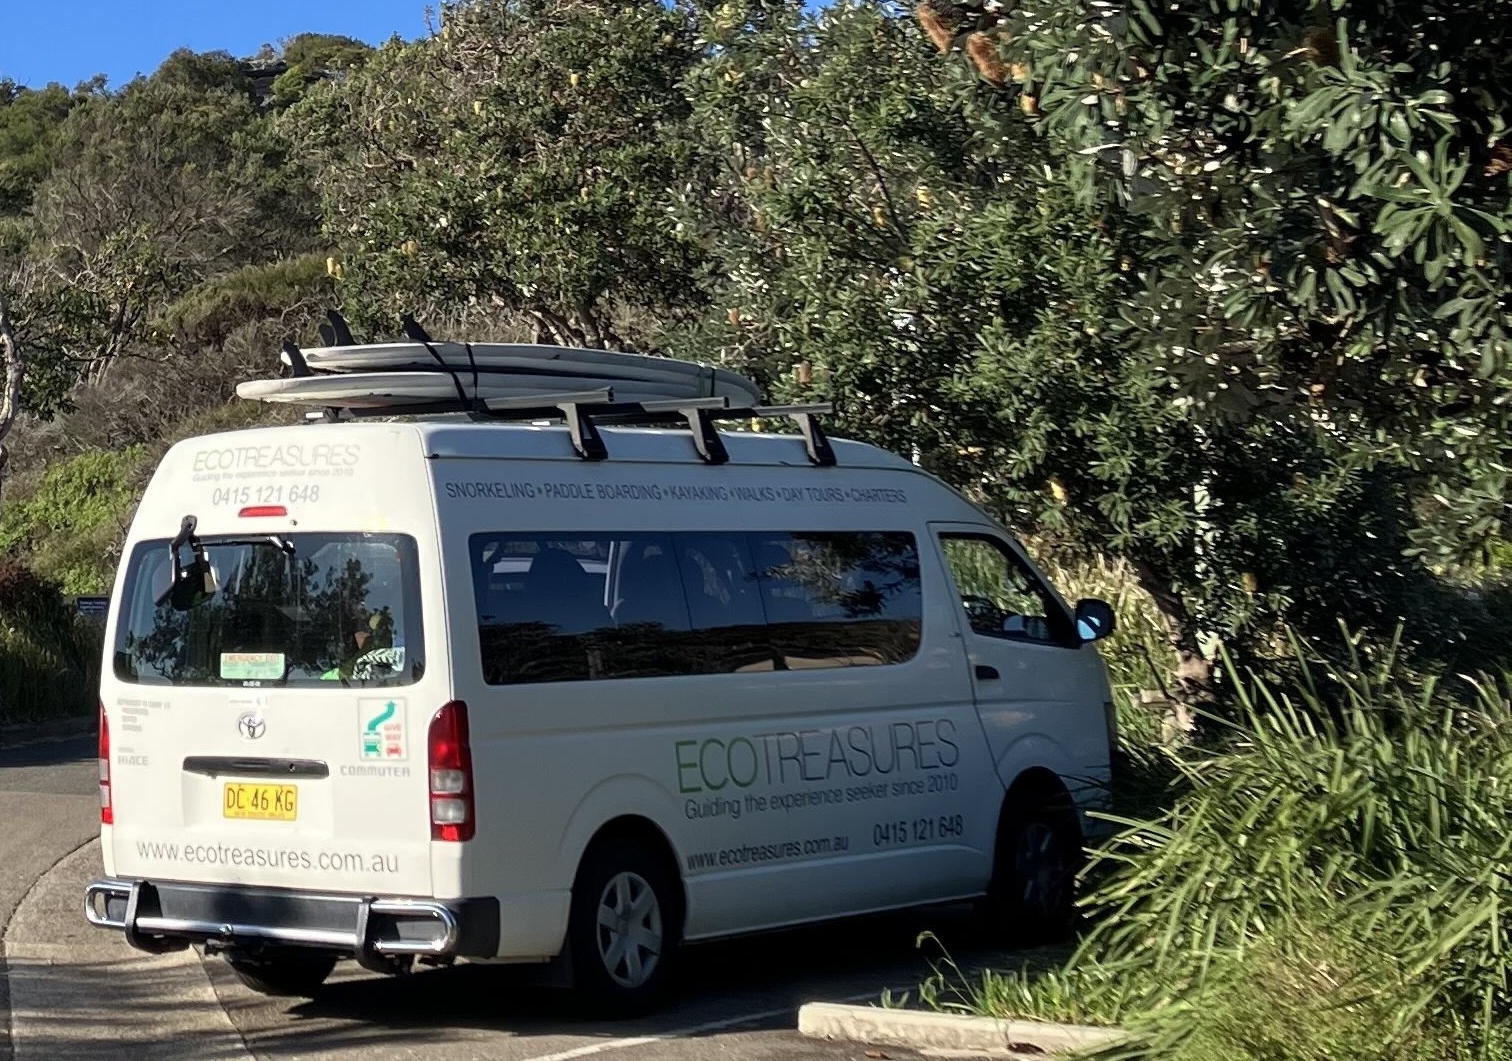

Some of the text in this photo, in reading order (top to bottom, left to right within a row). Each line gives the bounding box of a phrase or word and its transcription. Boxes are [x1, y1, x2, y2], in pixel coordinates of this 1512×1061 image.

[192, 443, 361, 472] ECOTREASURES
[212, 483, 320, 505] 0415 121 648
[444, 482, 908, 504] SNORKELING PADDLE BOARDING KAYAKING WALKS DAY TOURS CHARTERS
[340, 765, 411, 778] COMMUTER
[675, 719, 960, 794] ECOTREASURES
[227, 787, 294, 812] DC 46 KG
[684, 773, 958, 820] Guiding the experience seeker since 2010
[873, 814, 964, 846] 0415 121 648
[137, 840, 400, 873] www.ecotreasures.com.au
[687, 834, 850, 870] www.ecotreasures.com.au
